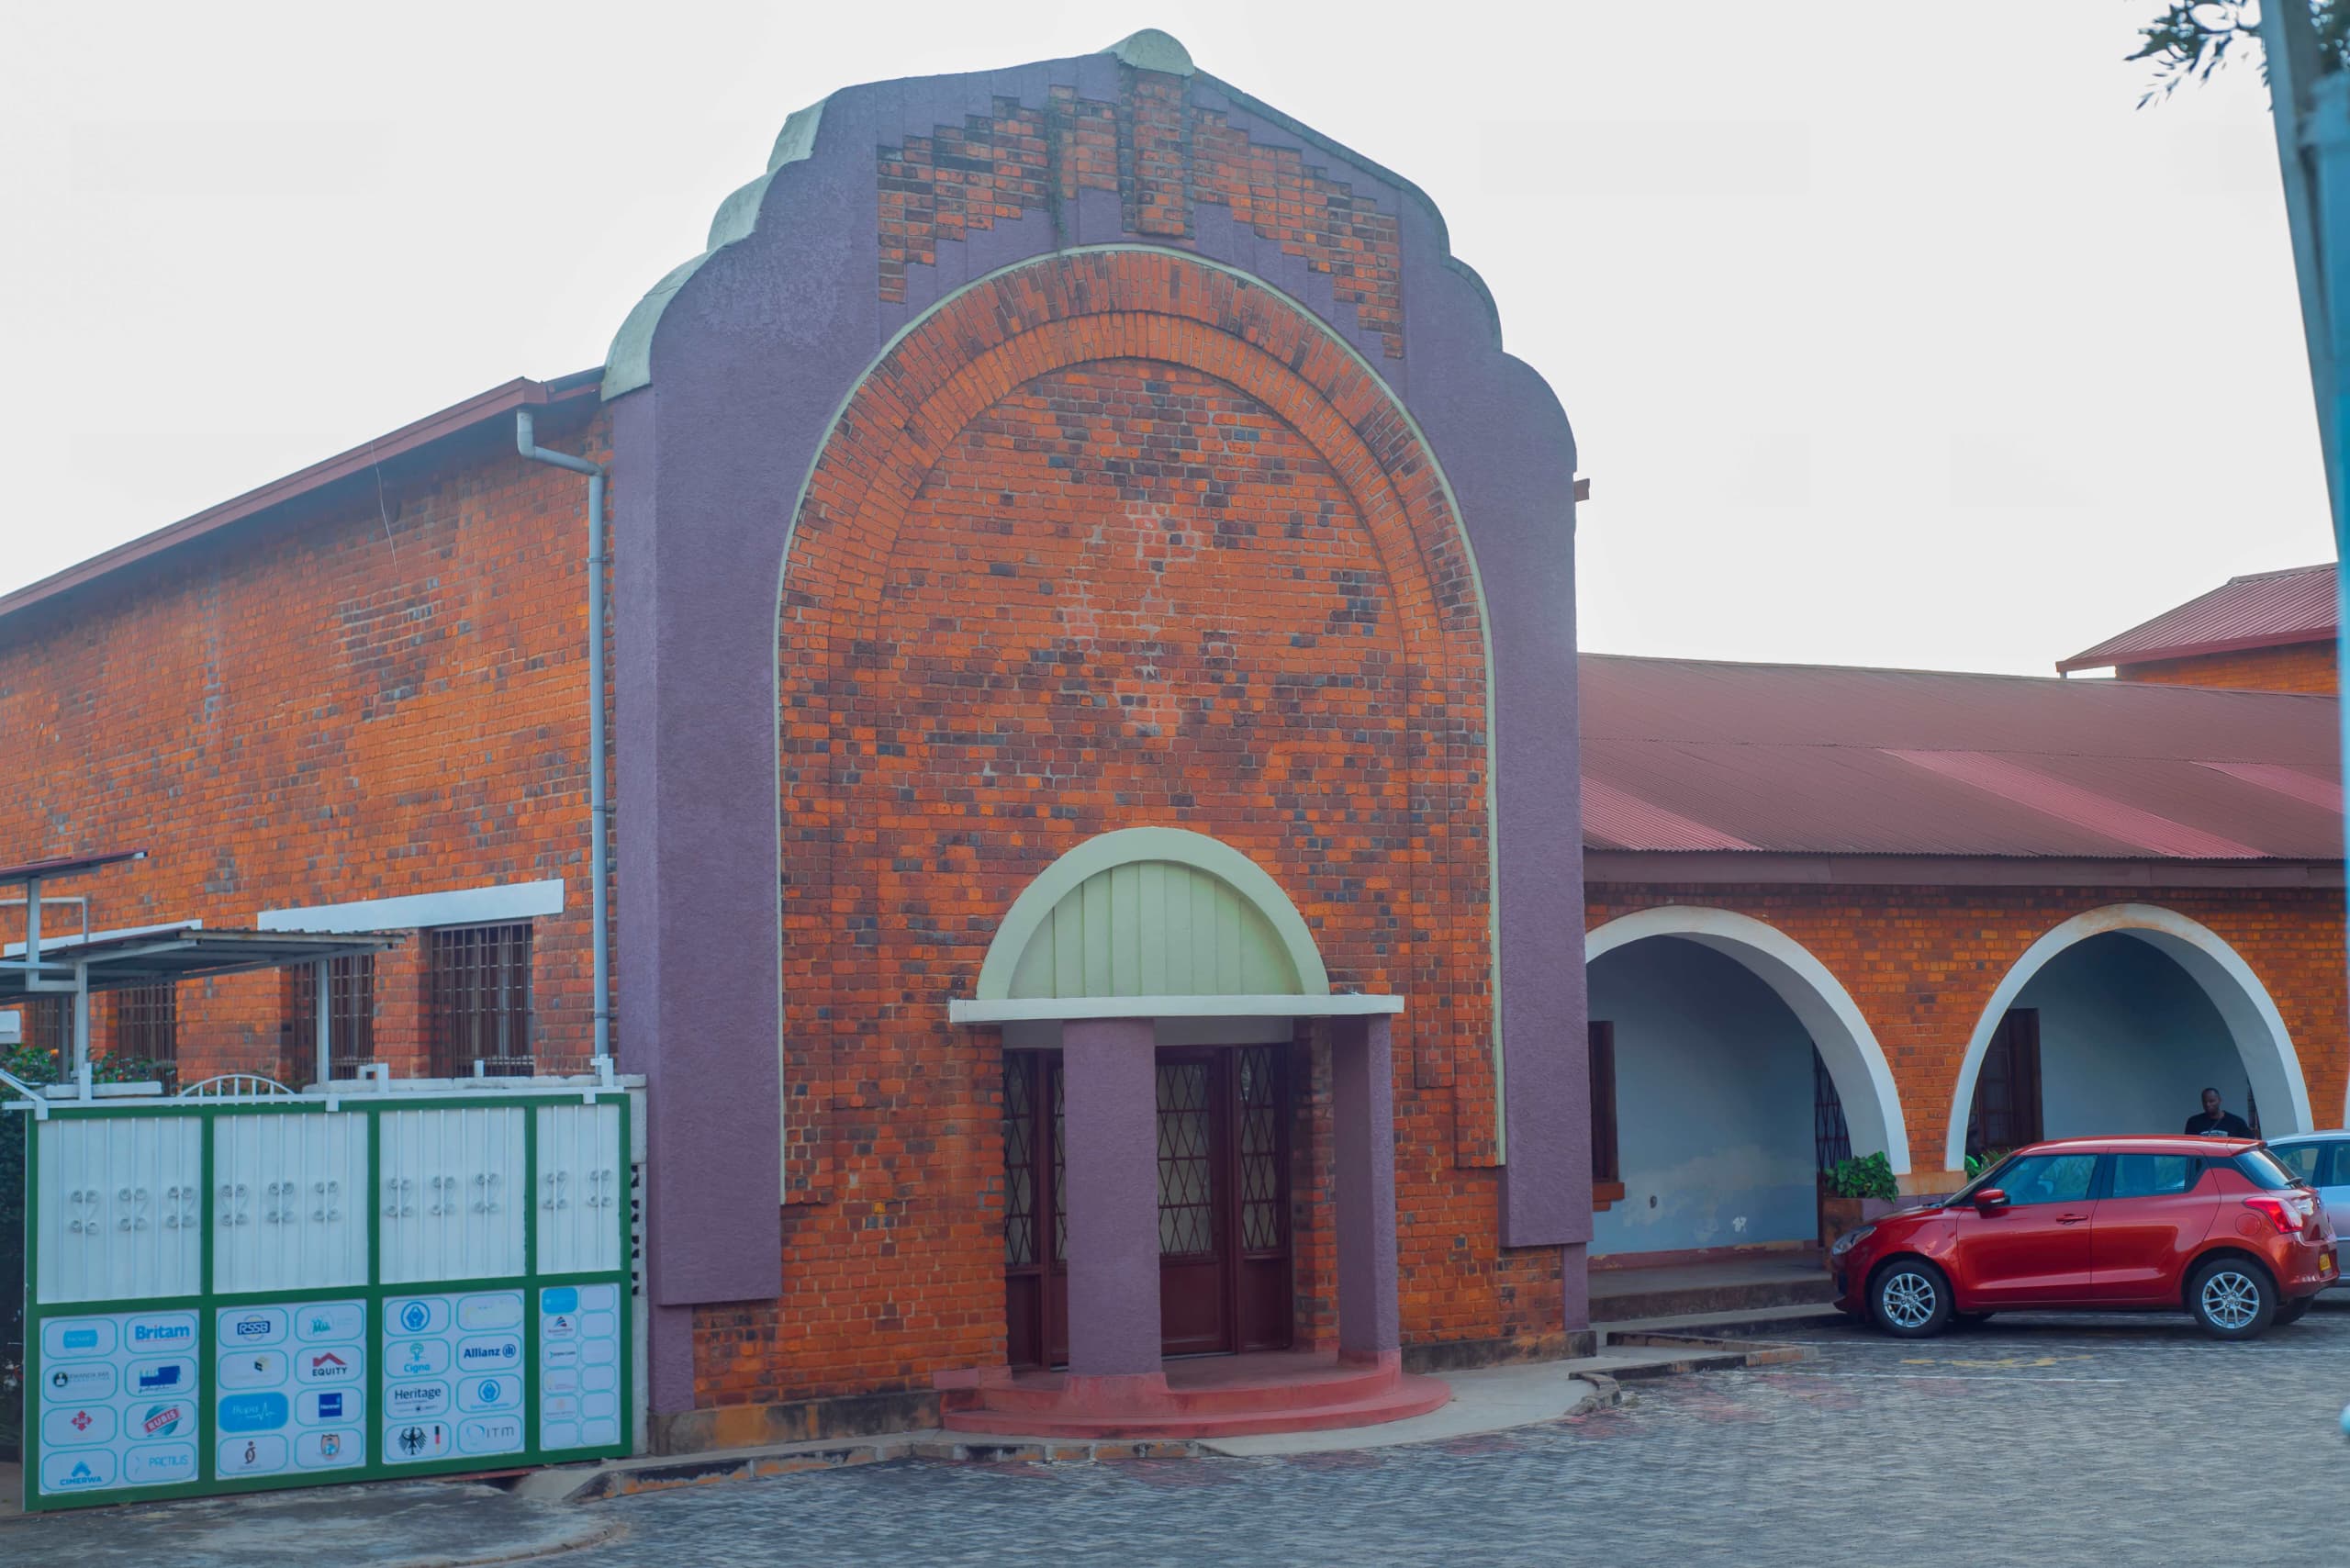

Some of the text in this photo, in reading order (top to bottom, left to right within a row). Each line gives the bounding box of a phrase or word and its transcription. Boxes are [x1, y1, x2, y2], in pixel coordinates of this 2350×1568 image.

[134, 1325, 190, 1340] Britam
[239, 1322, 269, 1335] RSSB
[463, 1347, 501, 1359] Allianz
[311, 1367, 348, 1377] EQUITY
[404, 1363, 431, 1373] Cigna
[394, 1387, 442, 1400] Heritage
[145, 1408, 177, 1433] RUBIS
[60, 1476, 103, 1486] CIMERWA
